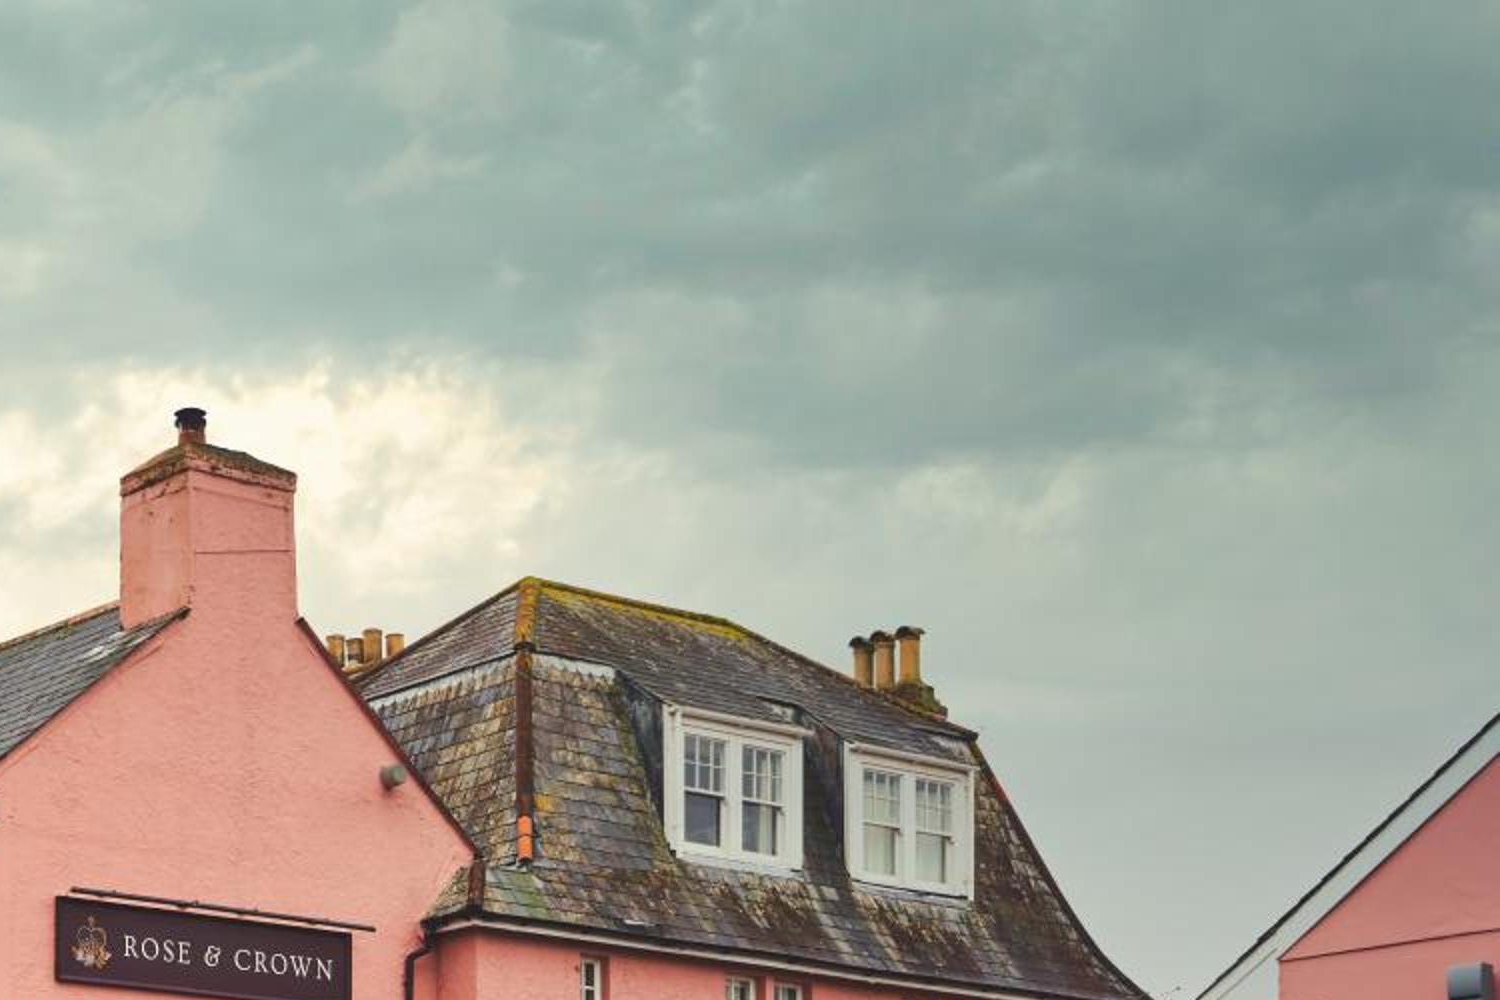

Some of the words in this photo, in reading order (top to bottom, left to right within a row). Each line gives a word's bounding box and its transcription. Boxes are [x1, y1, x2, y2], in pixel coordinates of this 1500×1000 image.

[123, 934, 191, 965] ROSE
[203, 945, 221, 967] &
[234, 949, 334, 981] CROWN
